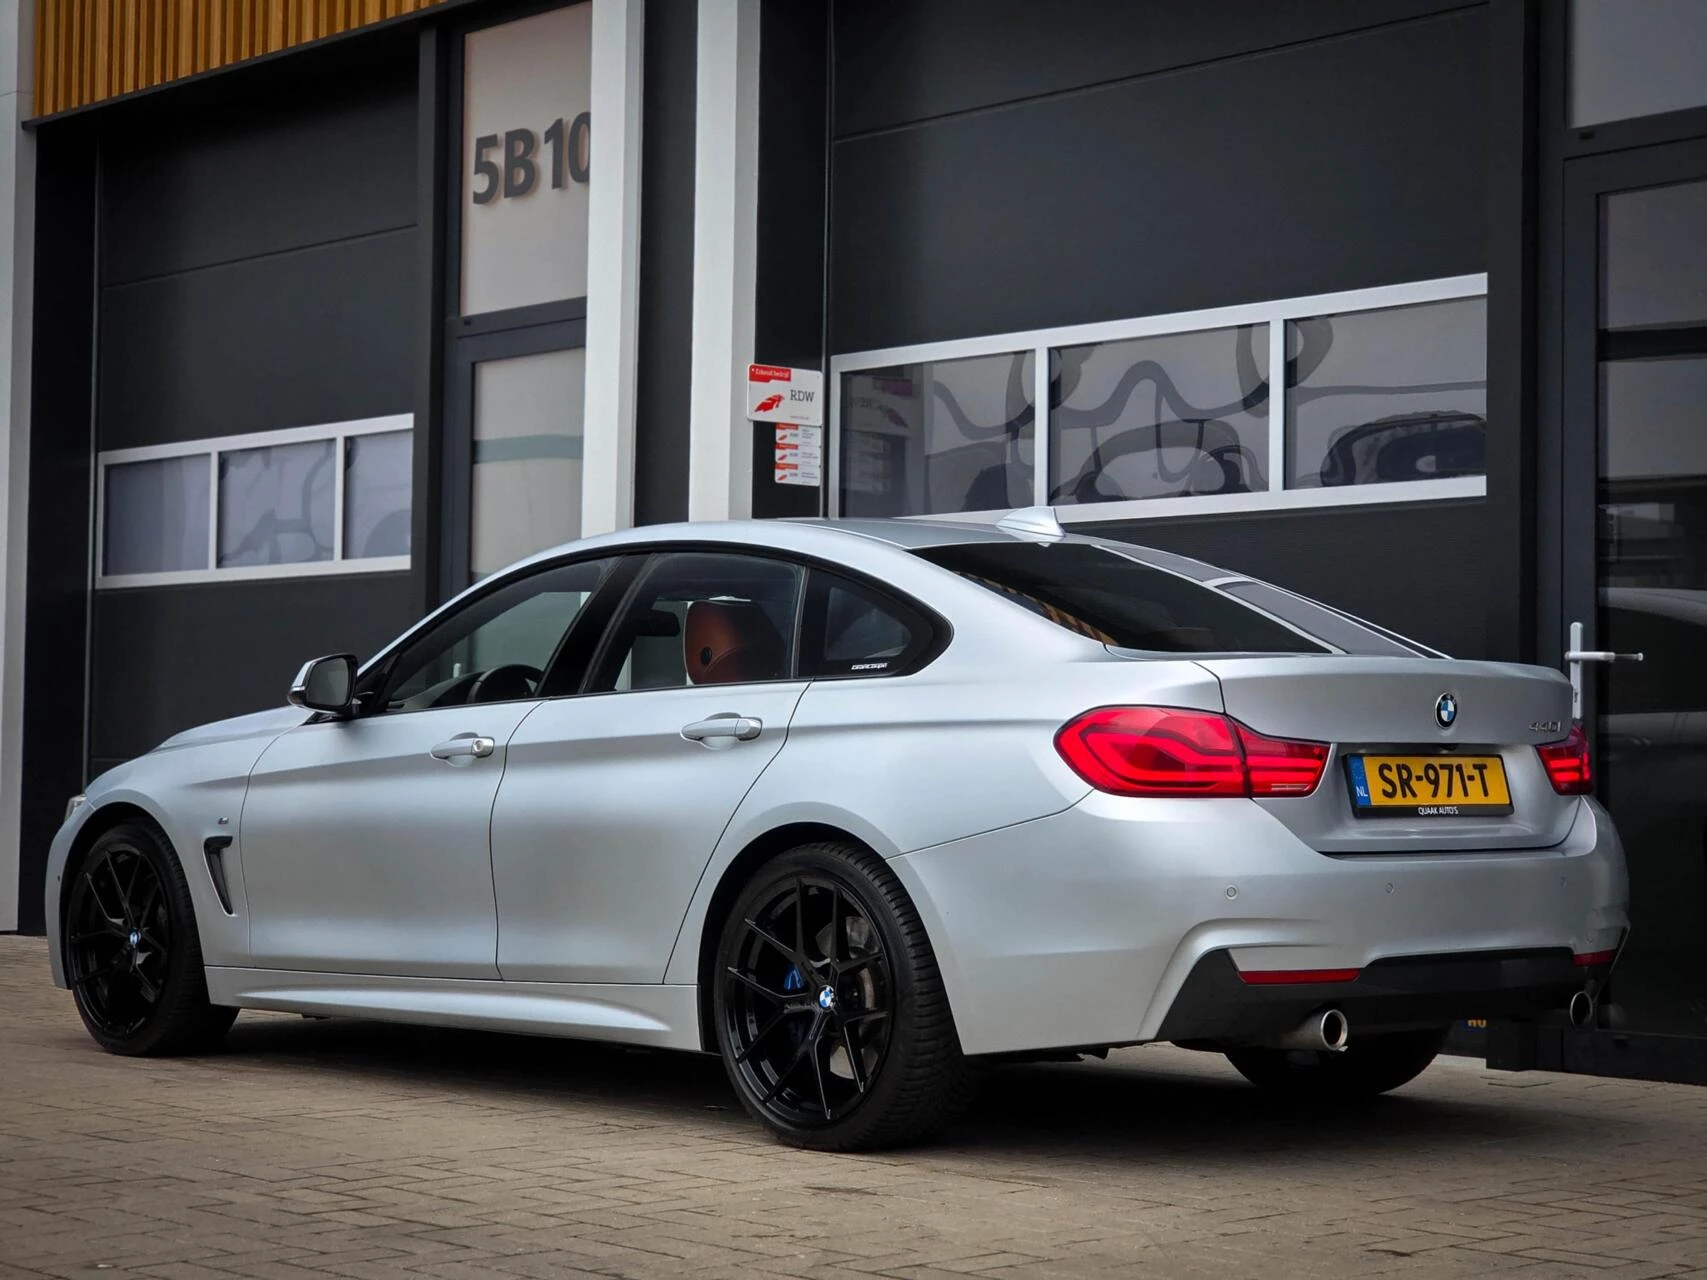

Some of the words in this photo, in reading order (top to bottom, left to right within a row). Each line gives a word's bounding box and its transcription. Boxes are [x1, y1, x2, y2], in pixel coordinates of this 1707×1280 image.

[473, 111, 591, 205] 5B10
[790, 389, 815, 402] RDW
[1378, 763, 1488, 799] SR-971-T
[1356, 786, 1369, 798] NL
[1417, 806, 1438, 816] QUAAK
